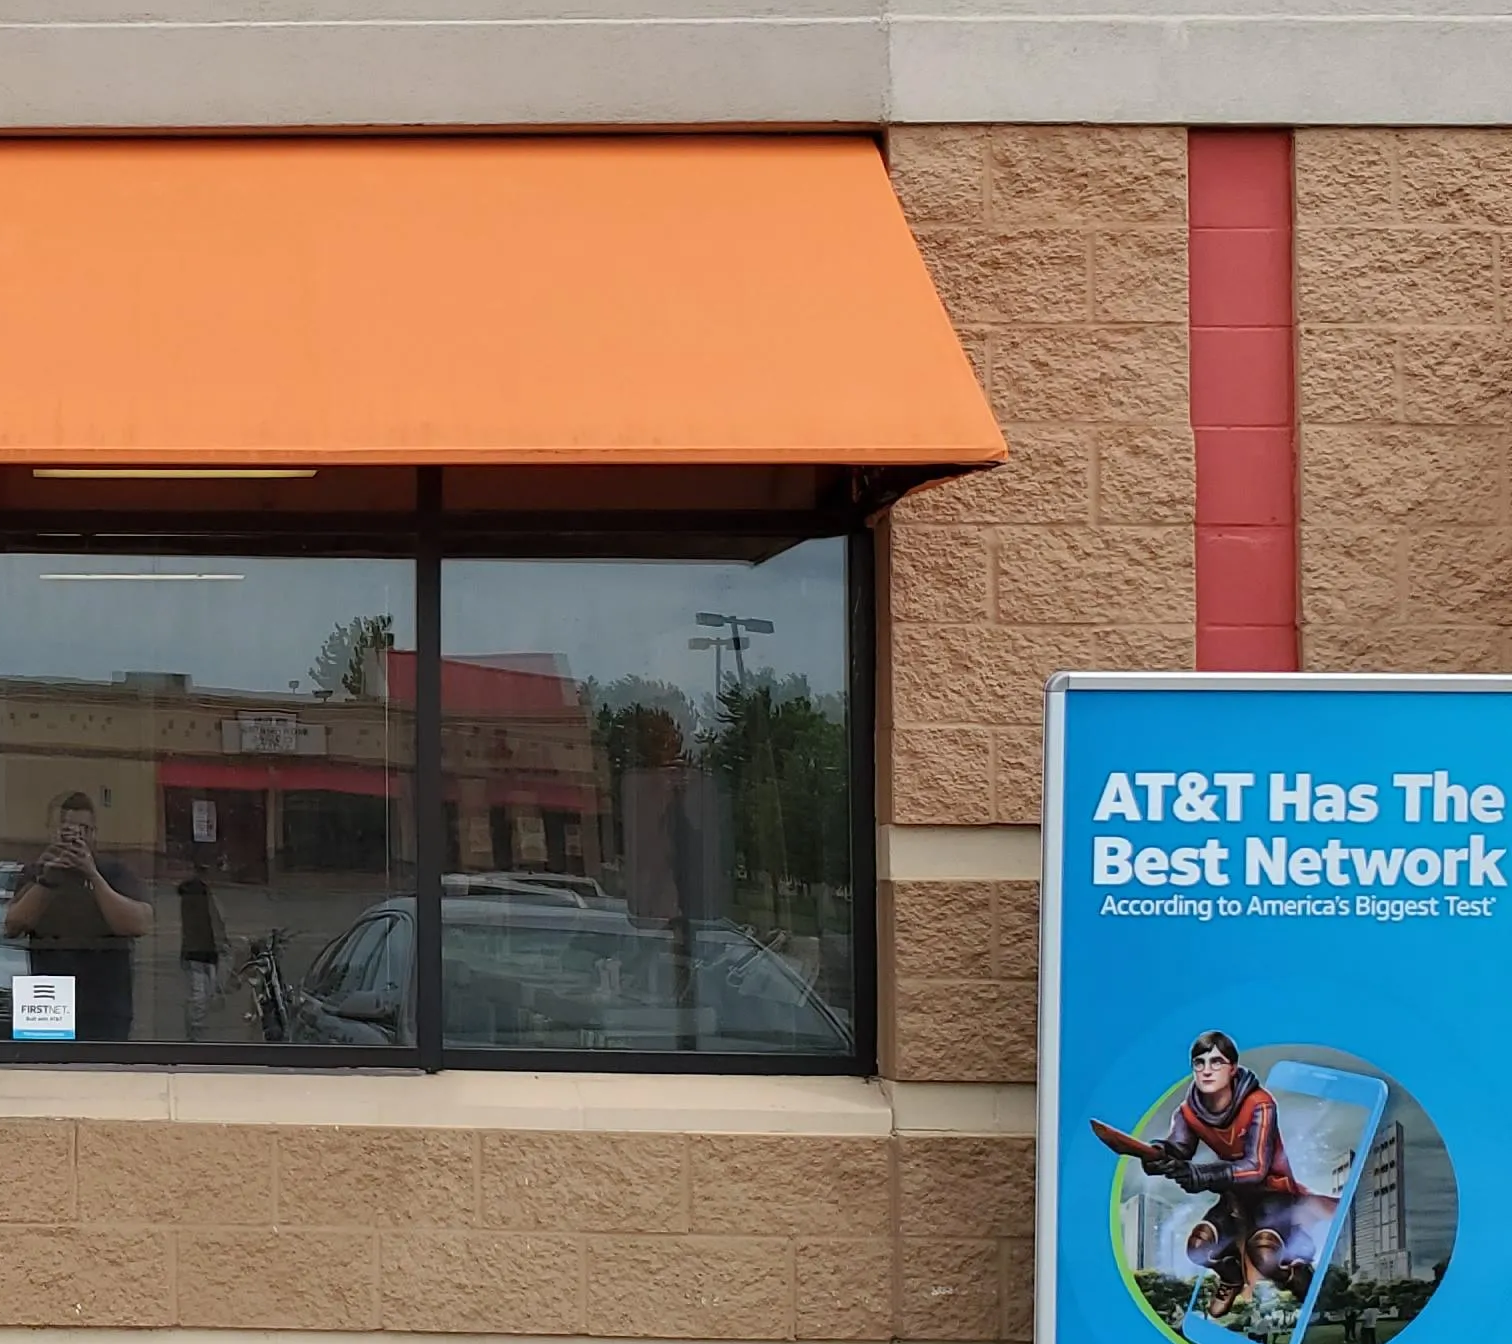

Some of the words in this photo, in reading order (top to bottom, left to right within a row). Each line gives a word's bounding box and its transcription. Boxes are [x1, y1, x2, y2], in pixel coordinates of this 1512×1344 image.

[1093, 771, 1255, 823] AT&T
[1269, 772, 1380, 824] Has
[1393, 770, 1506, 824] The
[1092, 835, 1230, 887] Best
[1245, 834, 1508, 887] Network
[1100, 894, 1213, 921] According
[1217, 897, 1242, 917] to
[1247, 895, 1350, 917] America's
[1356, 895, 1439, 922] Biggest
